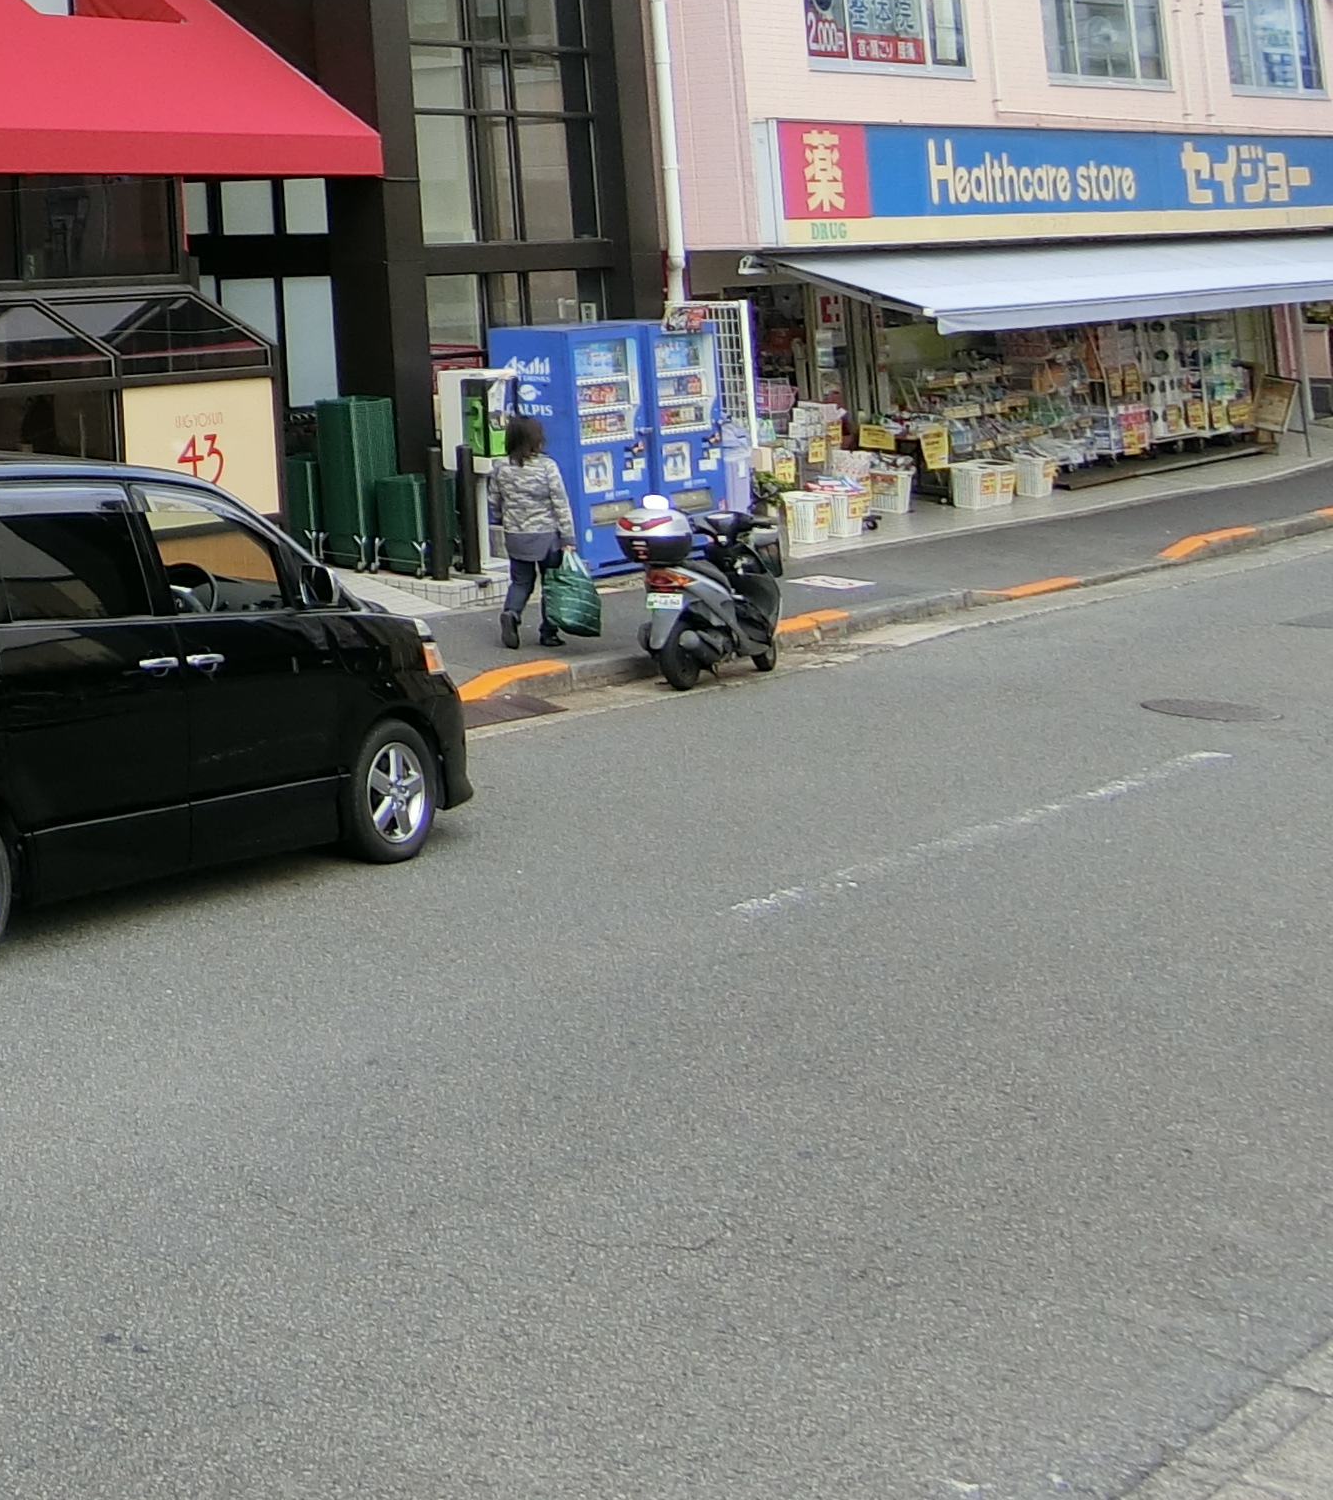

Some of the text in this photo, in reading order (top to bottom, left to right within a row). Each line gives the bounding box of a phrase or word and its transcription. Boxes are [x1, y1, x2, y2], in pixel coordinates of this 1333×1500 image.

[801, 129, 847, 212] 薬
[927, 138, 1136, 205] Healthcare store
[1180, 141, 1312, 204] セイジョー
[810, 222, 848, 240] DRUG
[177, 434, 224, 485] 43
